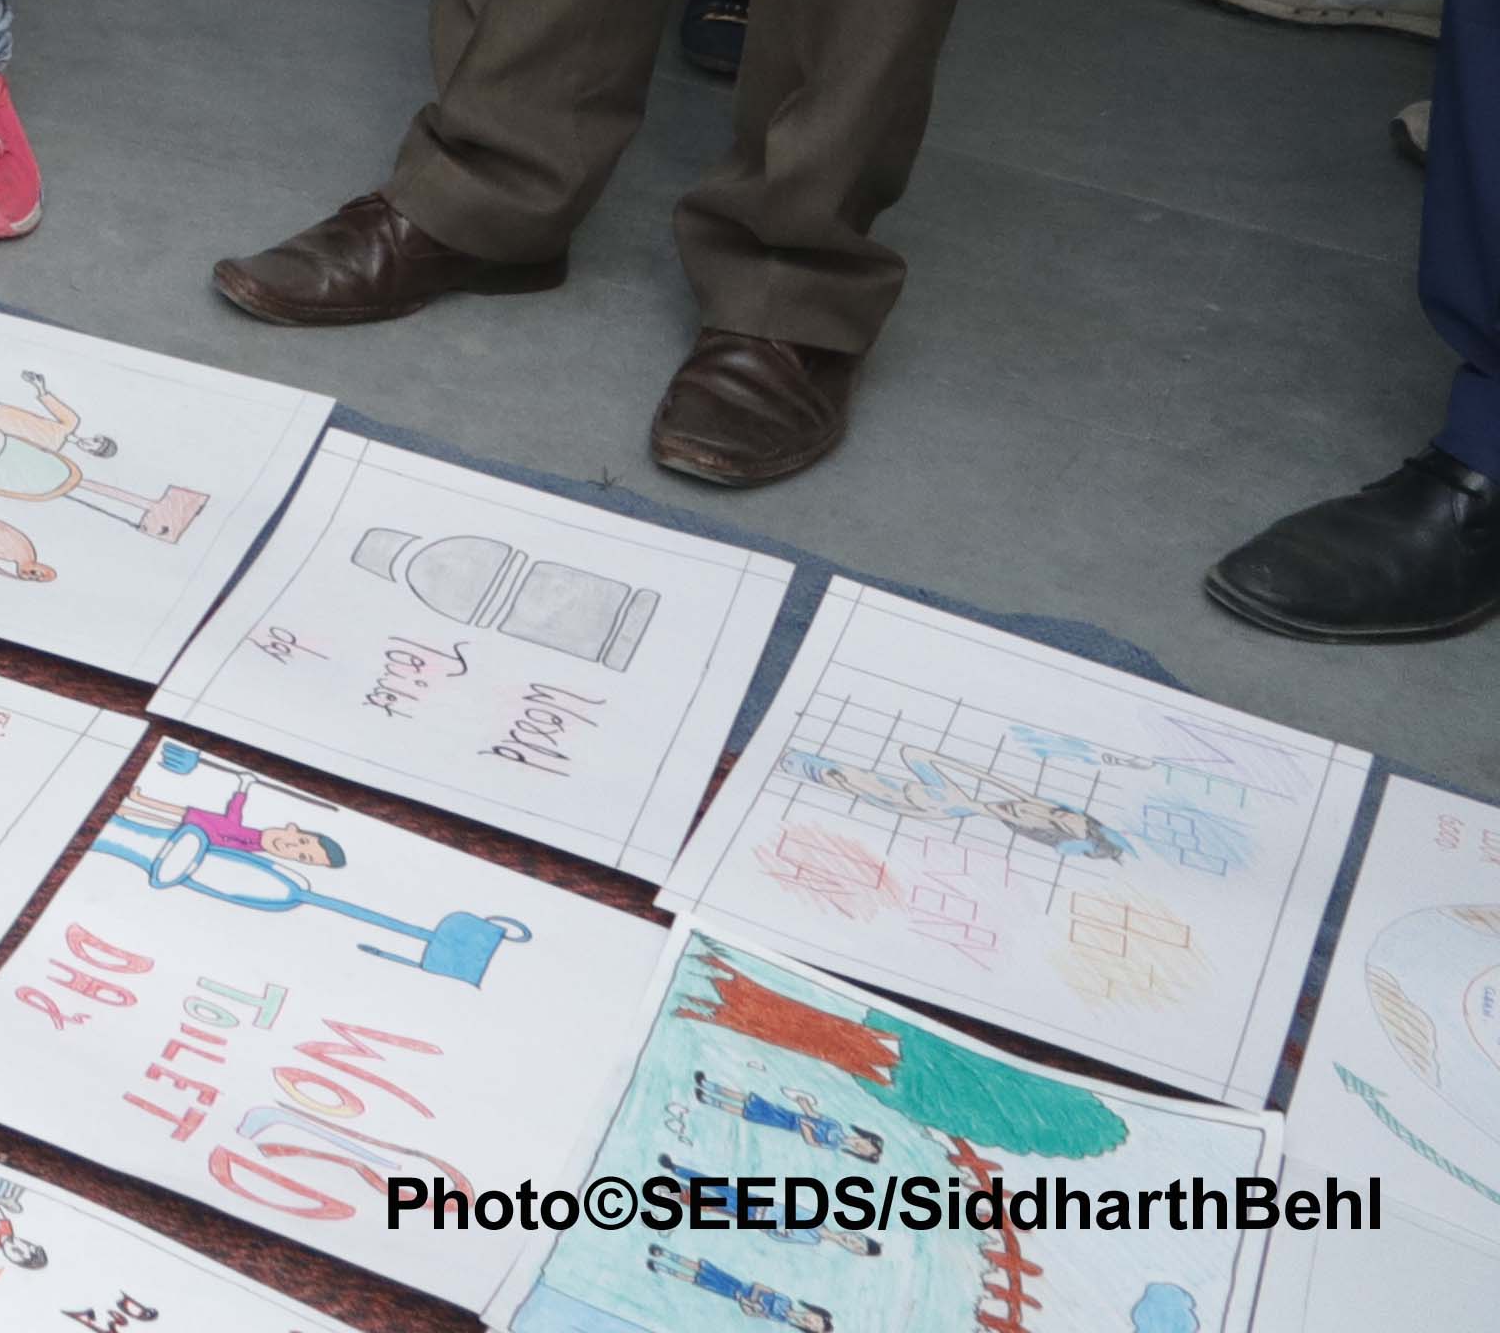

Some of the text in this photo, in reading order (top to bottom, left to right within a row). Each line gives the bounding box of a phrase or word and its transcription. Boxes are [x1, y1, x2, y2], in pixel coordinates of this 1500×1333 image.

[245, 625, 332, 667] day
[360, 635, 476, 721] Toilet
[123, 976, 289, 1142] TOILET
